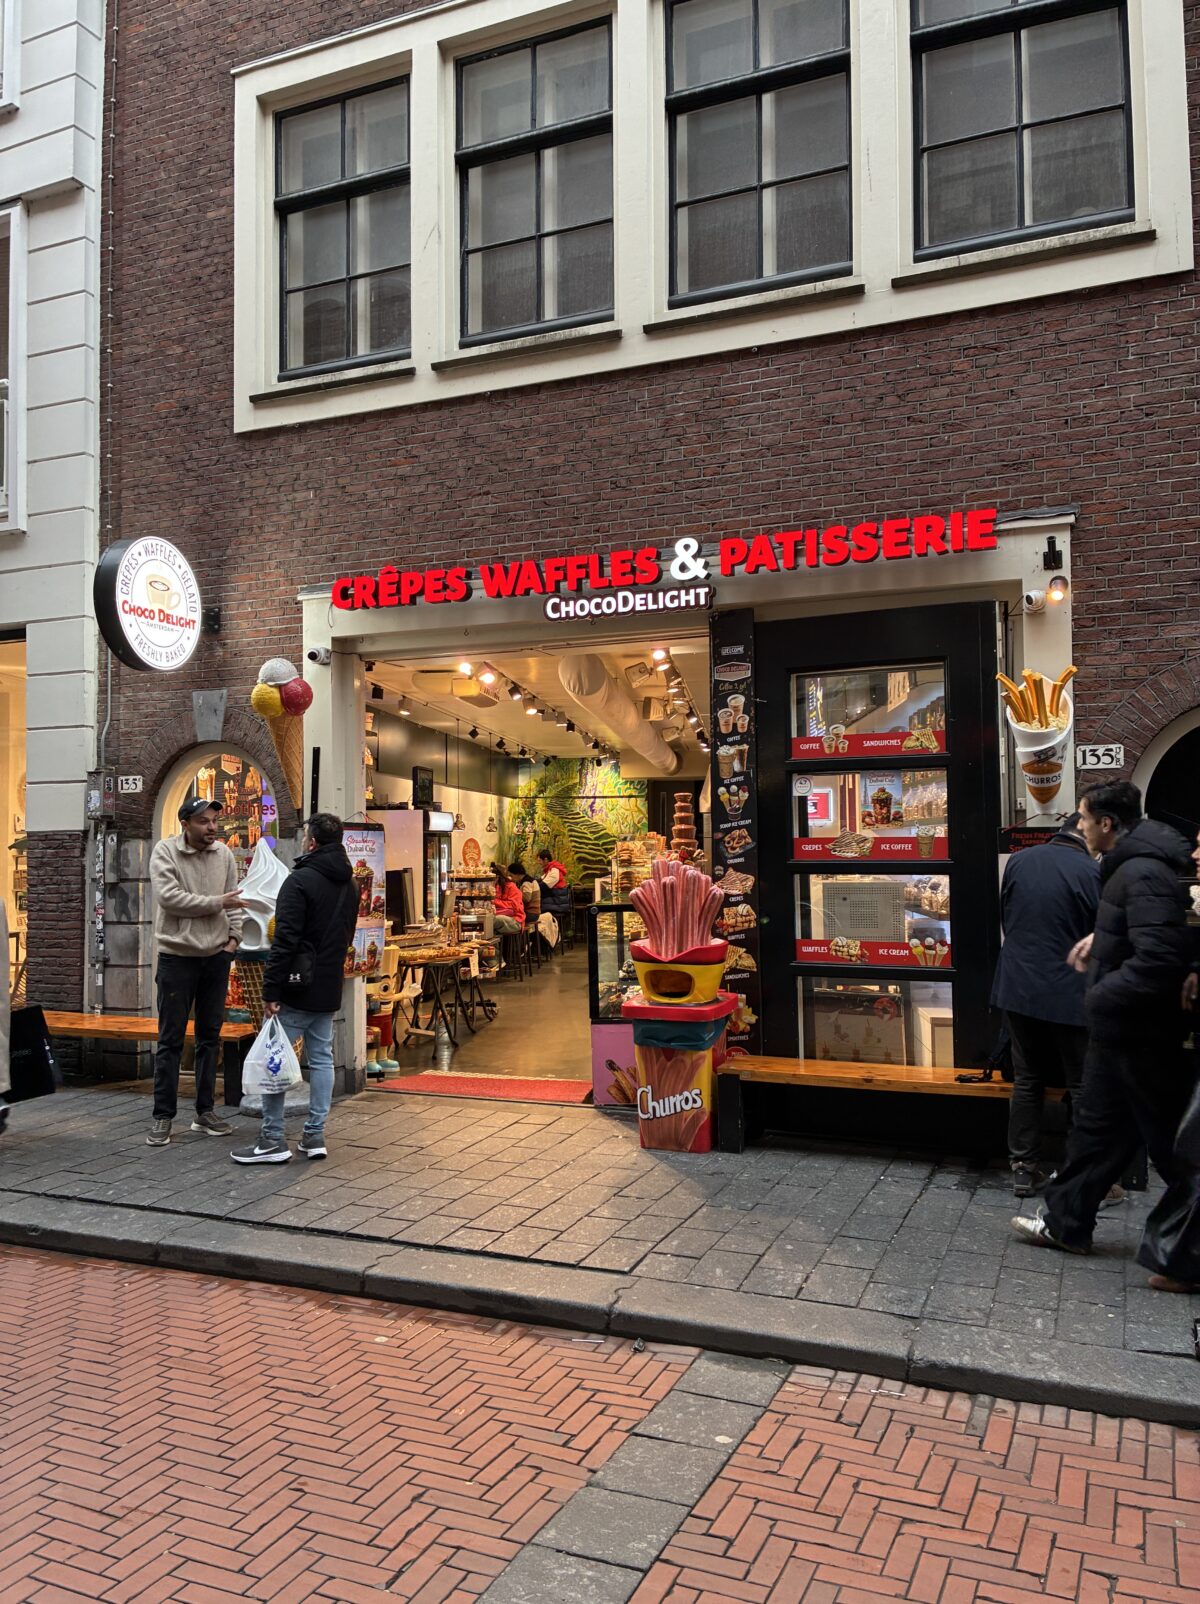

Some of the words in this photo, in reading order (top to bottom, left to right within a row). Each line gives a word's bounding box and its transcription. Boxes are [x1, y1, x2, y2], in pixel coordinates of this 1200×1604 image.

[331, 565, 468, 610] CRÊPES
[480, 547, 660, 598] WAFFLES
[670, 537, 709, 581] &
[719, 508, 998, 576] PATISSERIE
[142, 542, 178, 567] WAFFLES
[181, 570, 198, 614] GELATO
[133, 634, 164, 663] FRESHLY
[165, 643, 187, 663] BAKED
[863, 739, 901, 747] SANDWICHES
[1080, 748, 1114, 766] 135
[1024, 774, 1061, 785] CHURROS
[891, 843, 913, 851] COFFEE
[637, 1085, 703, 1119] Churros
